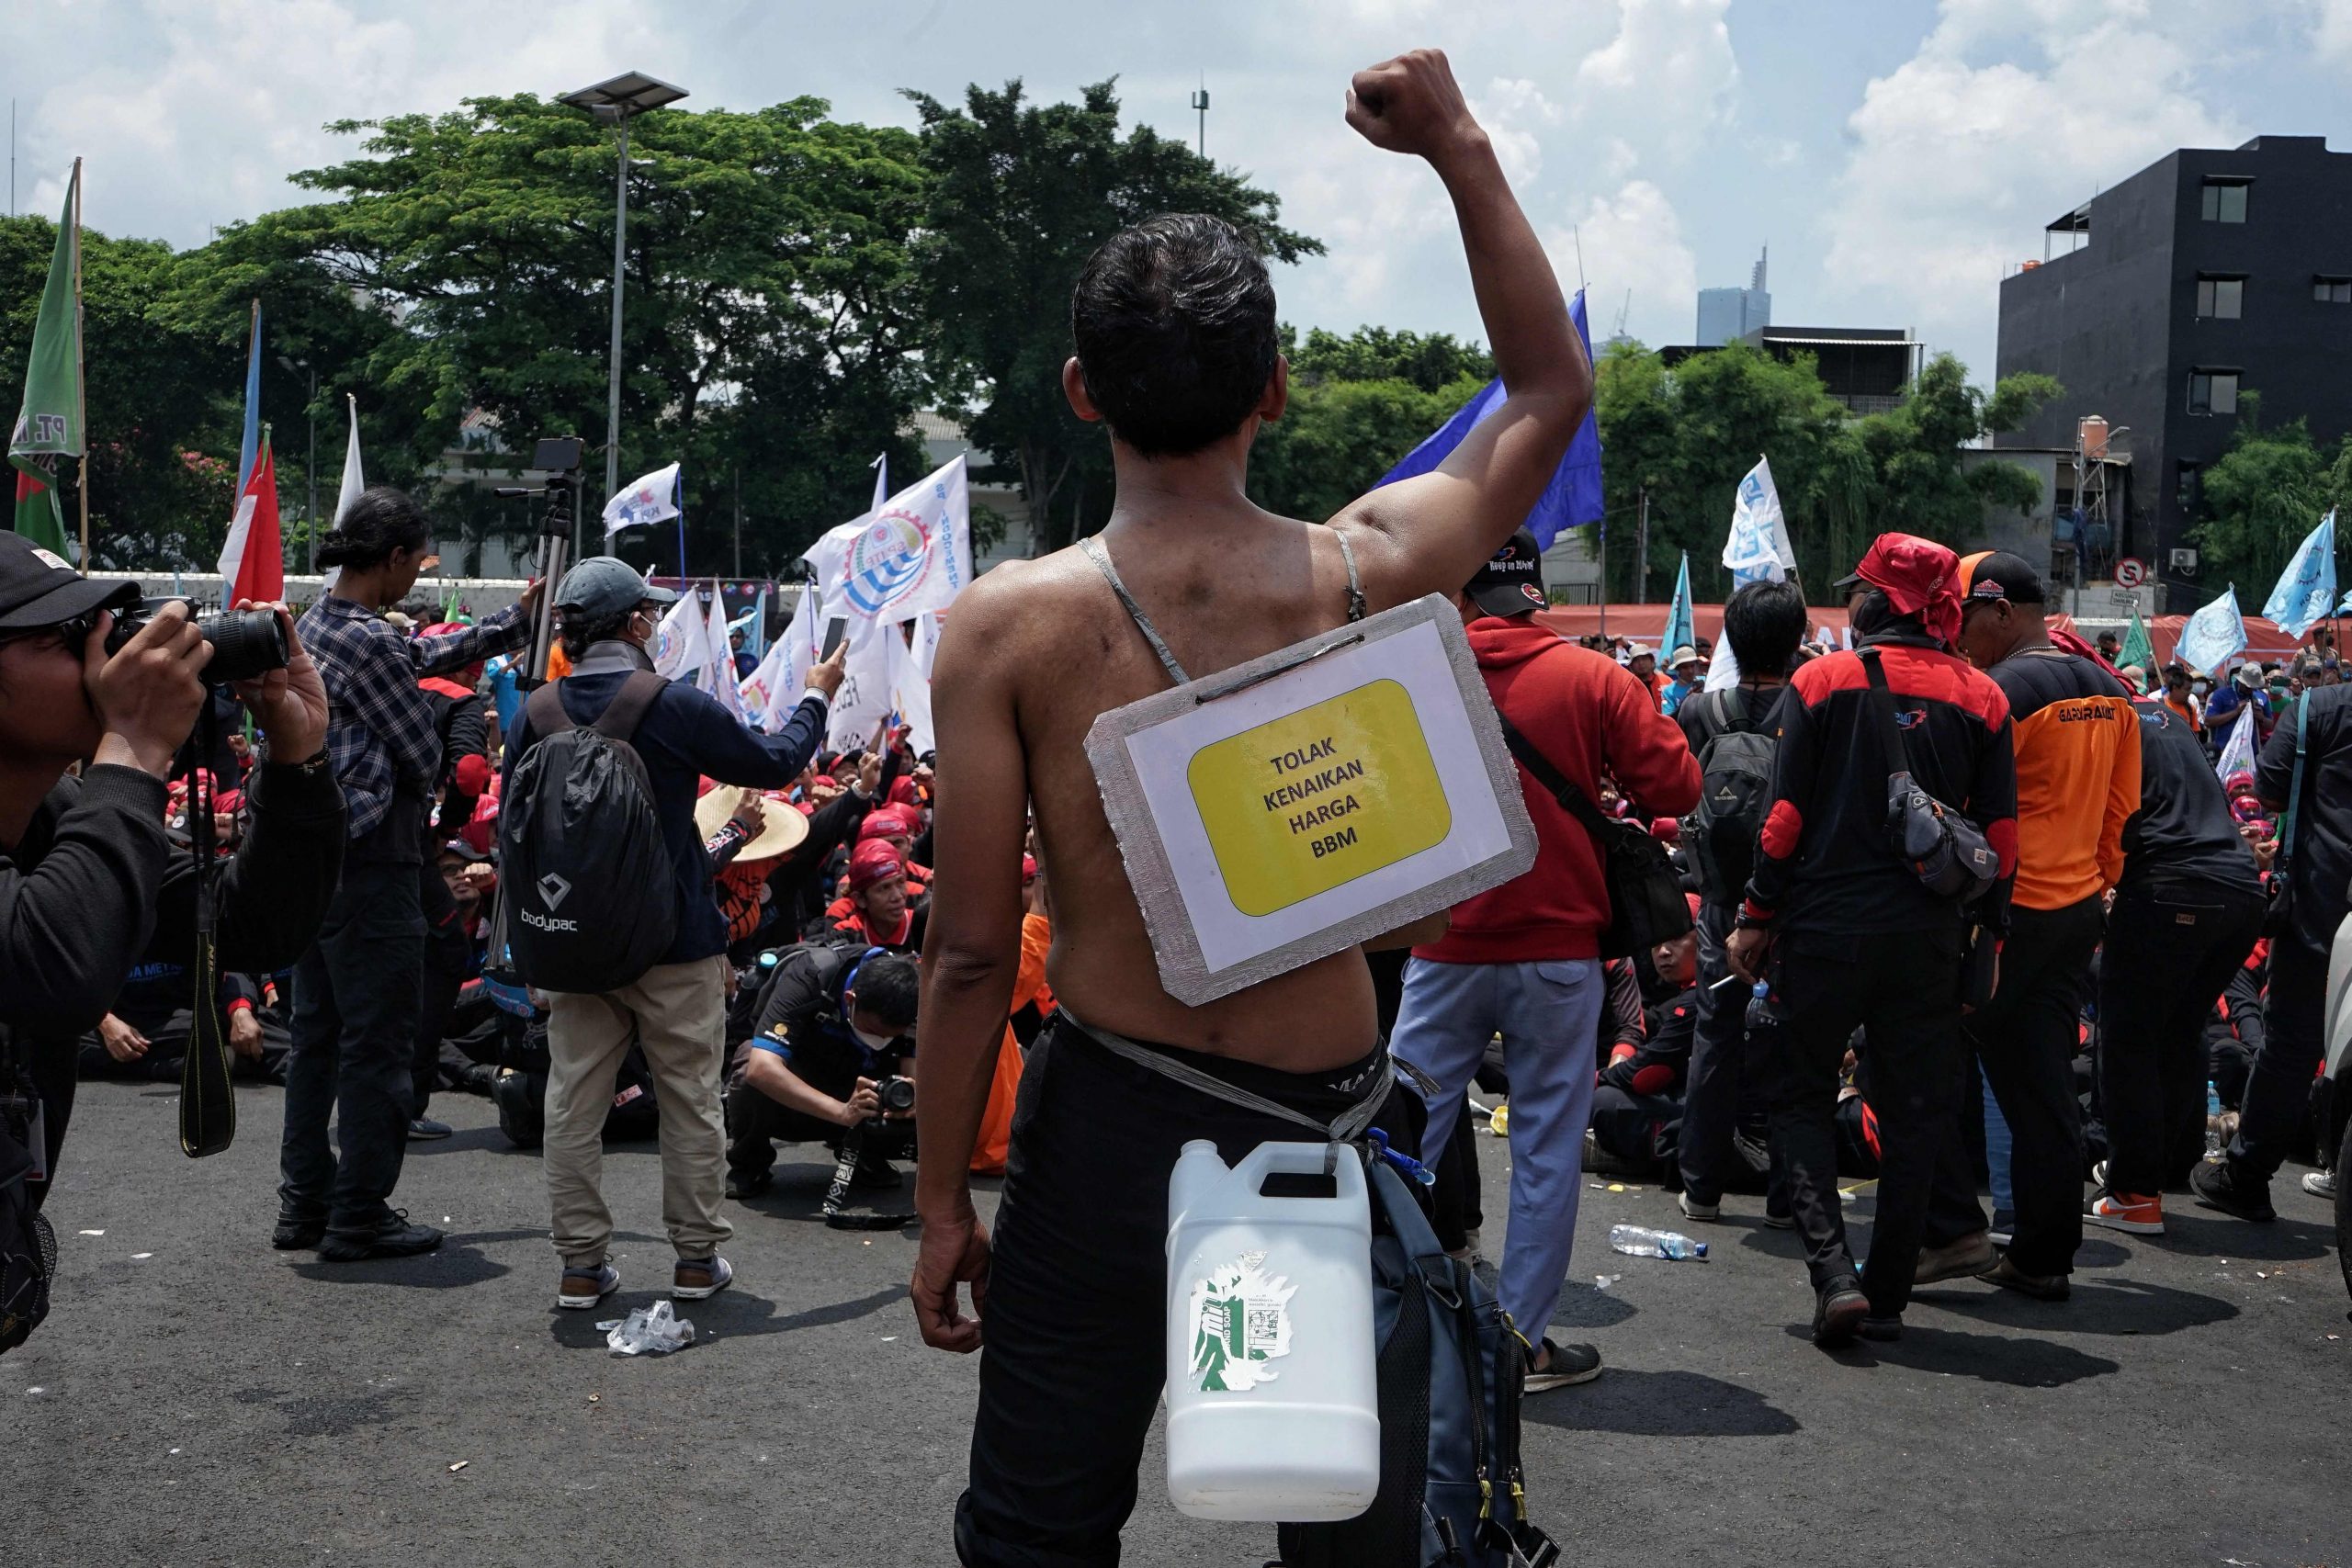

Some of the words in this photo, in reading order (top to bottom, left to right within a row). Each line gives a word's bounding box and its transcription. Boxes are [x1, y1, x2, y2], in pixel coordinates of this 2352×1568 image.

[1270, 737, 1338, 774] TOLAK
[1263, 759, 1364, 812] KENAIKAN
[1288, 795, 1361, 835] HARGA
[1310, 827, 1359, 859] BBM
[521, 908, 578, 932] bodypac
[1223, 1306, 1231, 1328] SOAP
